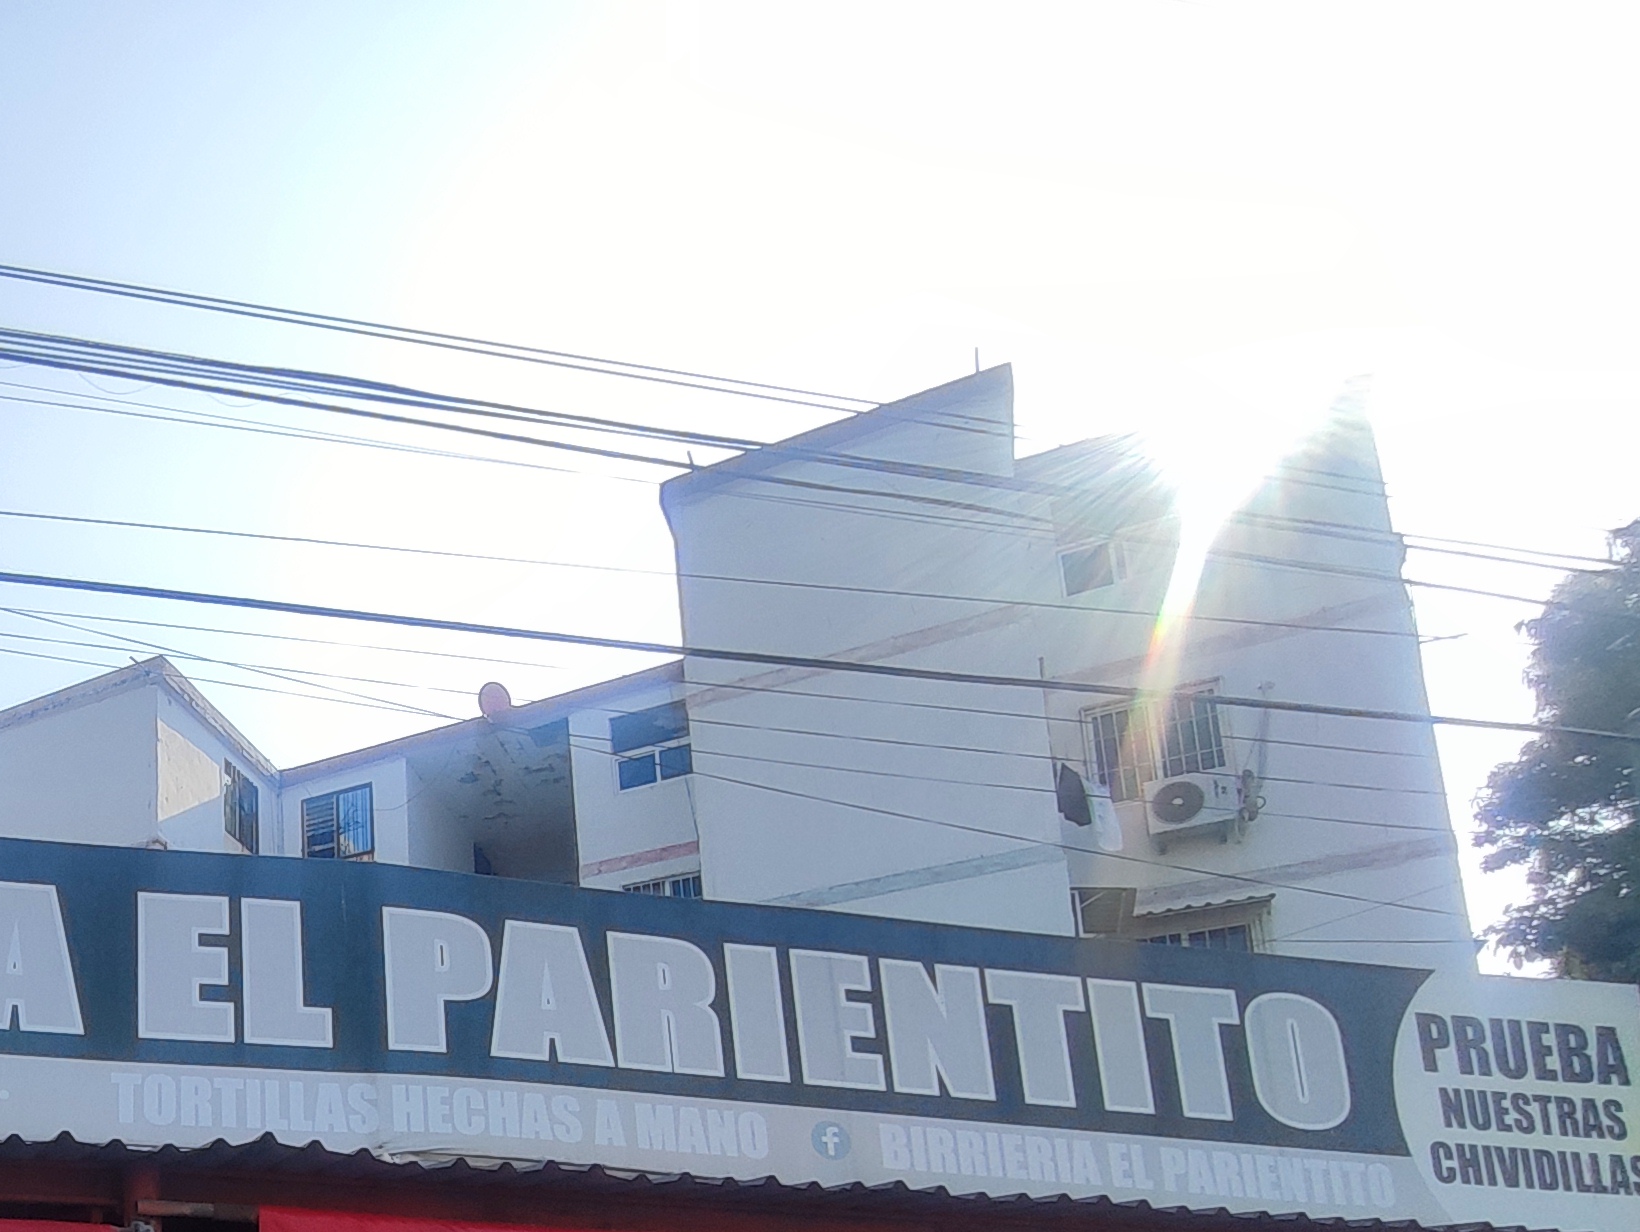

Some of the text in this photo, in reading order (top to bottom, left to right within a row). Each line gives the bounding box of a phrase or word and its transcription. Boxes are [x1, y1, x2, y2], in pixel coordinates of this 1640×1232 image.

[136, 890, 335, 1050] EL
[381, 905, 1351, 1131] PARIENTITO
[1414, 1011, 1632, 1087] PRUEBA
[111, 1071, 770, 1161] TORTILLAS HECHAS A MANO
[1438, 1086, 1629, 1141] NUESTRAS
[877, 1122, 1397, 1208] BIRRIERIA EL PARIENTITO
